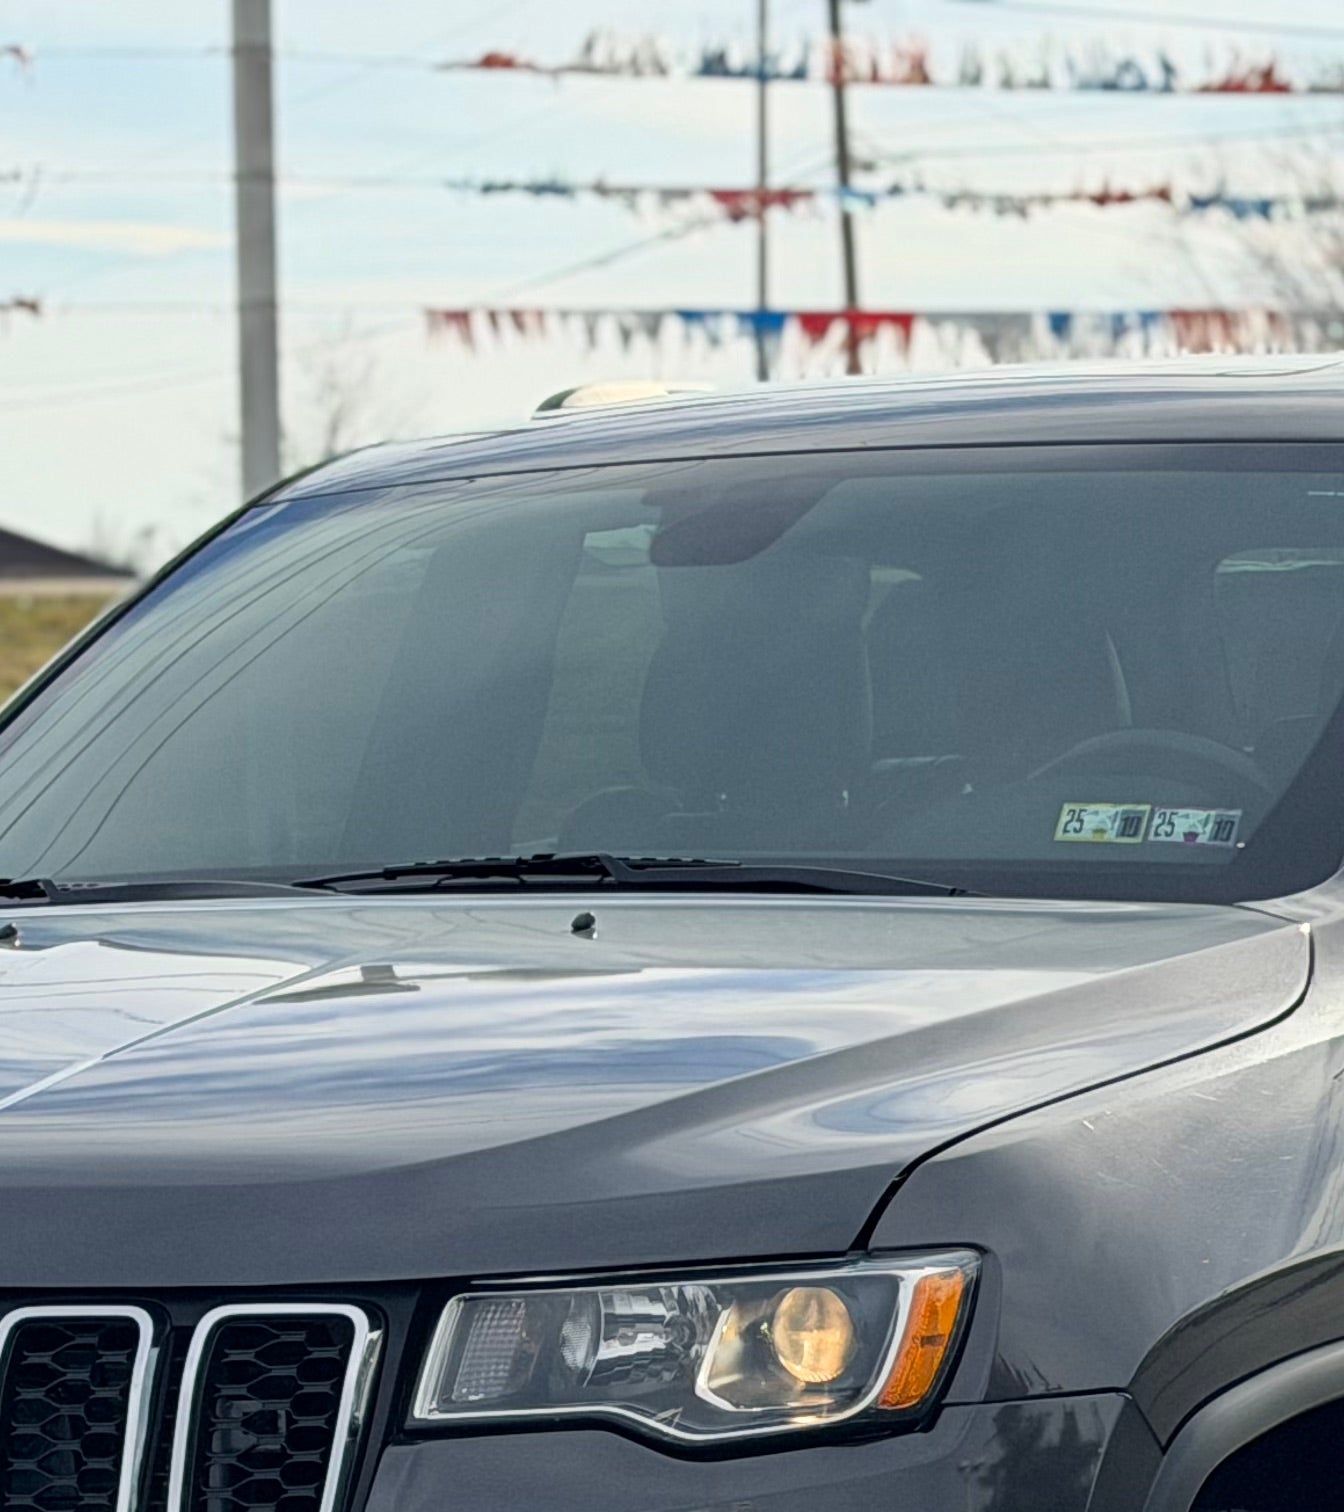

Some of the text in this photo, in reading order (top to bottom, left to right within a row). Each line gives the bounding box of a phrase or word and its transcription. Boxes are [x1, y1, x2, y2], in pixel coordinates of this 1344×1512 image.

[1062, 808, 1143, 838] 25 10
[1154, 811, 1236, 842] 25 10
